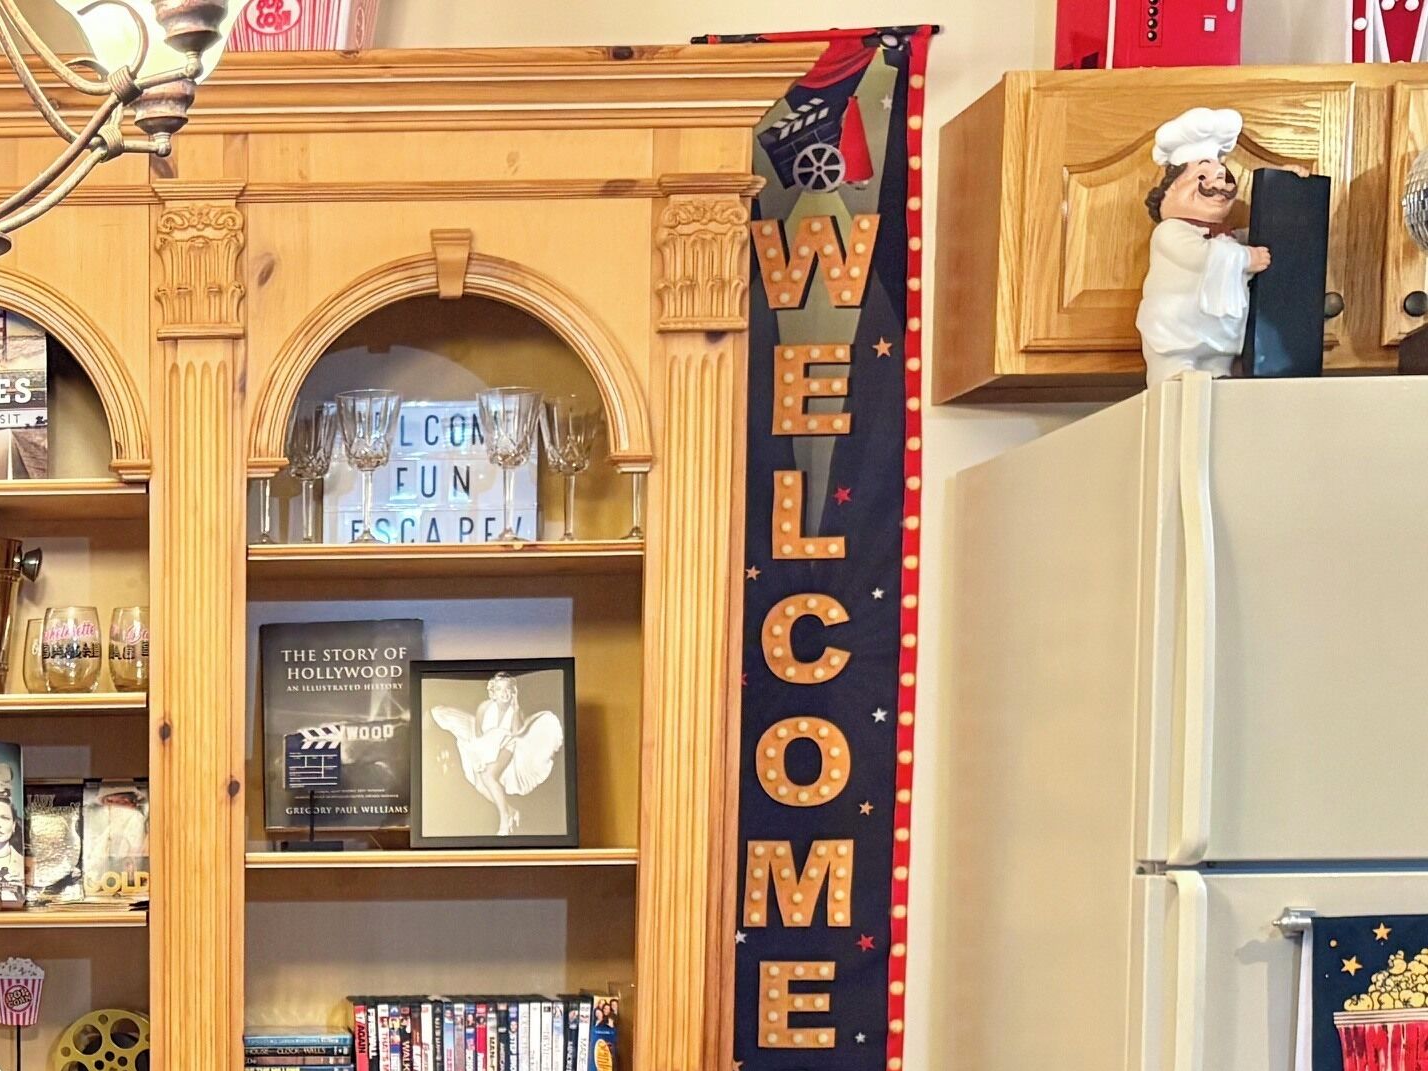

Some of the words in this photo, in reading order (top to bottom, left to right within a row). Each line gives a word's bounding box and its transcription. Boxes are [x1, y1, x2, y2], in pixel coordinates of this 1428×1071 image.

[396, 465, 470, 498] FUN
[743, 214, 881, 1049] WELCOME
[281, 649, 317, 662] THE
[323, 647, 378, 662] STORY
[384, 647, 408, 660] OF
[287, 665, 403, 680] HOLLYWOOD
[302, 684, 361, 692] ILLUSTRATED
[364, 682, 404, 691] HISTORY
[335, 805, 358, 814] PAUL
[360, 804, 409, 814] WILLIAMS
[401, 1040, 410, 1071] WALK
